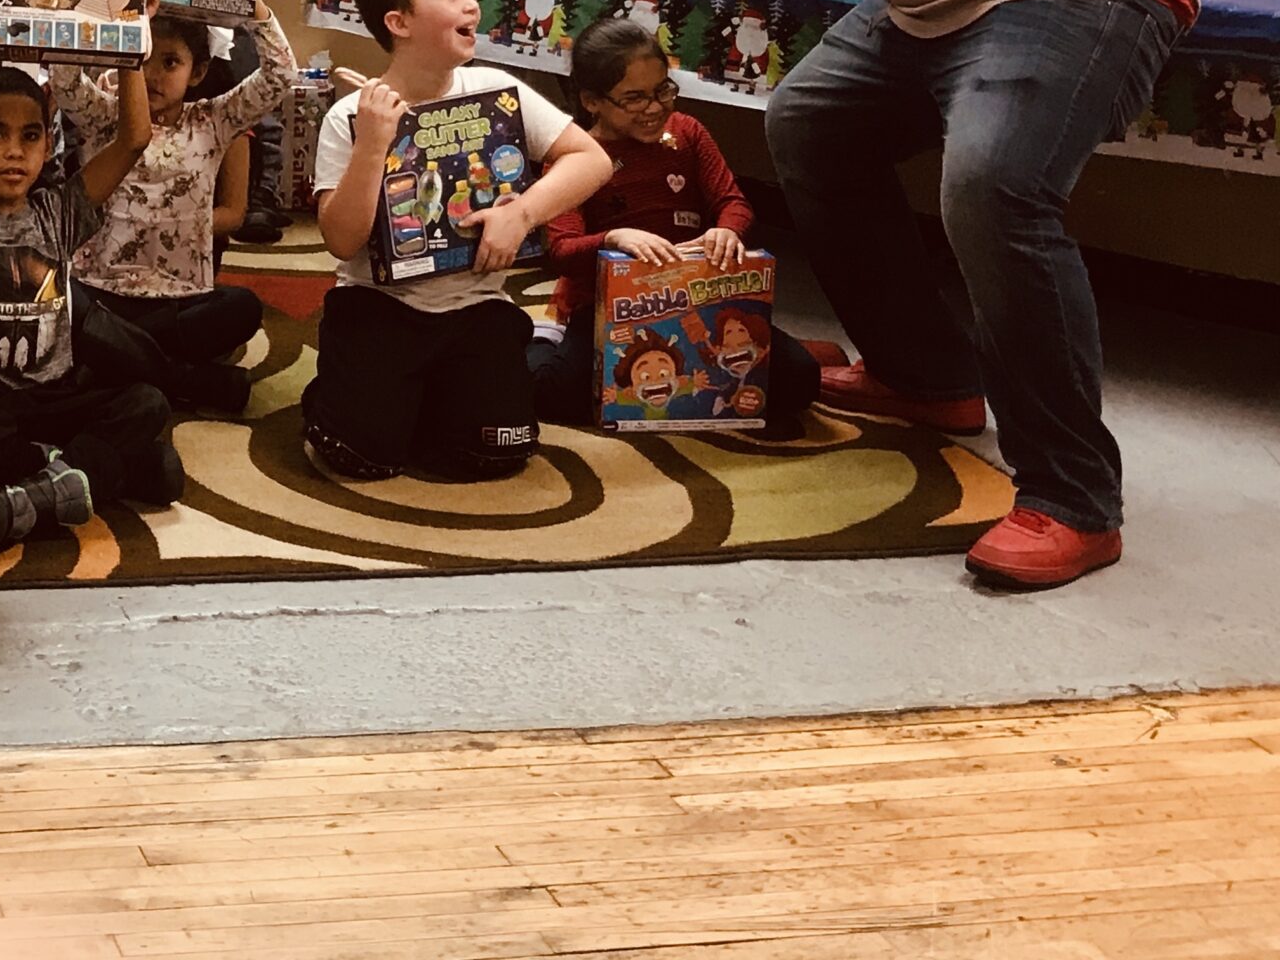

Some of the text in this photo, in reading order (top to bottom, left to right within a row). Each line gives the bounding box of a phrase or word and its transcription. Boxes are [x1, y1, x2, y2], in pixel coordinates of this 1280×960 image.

[497, 91, 519, 112] 3D
[418, 102, 482, 128] GALAXY
[413, 117, 492, 149] GLITTER
[425, 137, 486, 160] SAND ART
[433, 228, 443, 239] 4
[0, 302, 15, 314] TO
